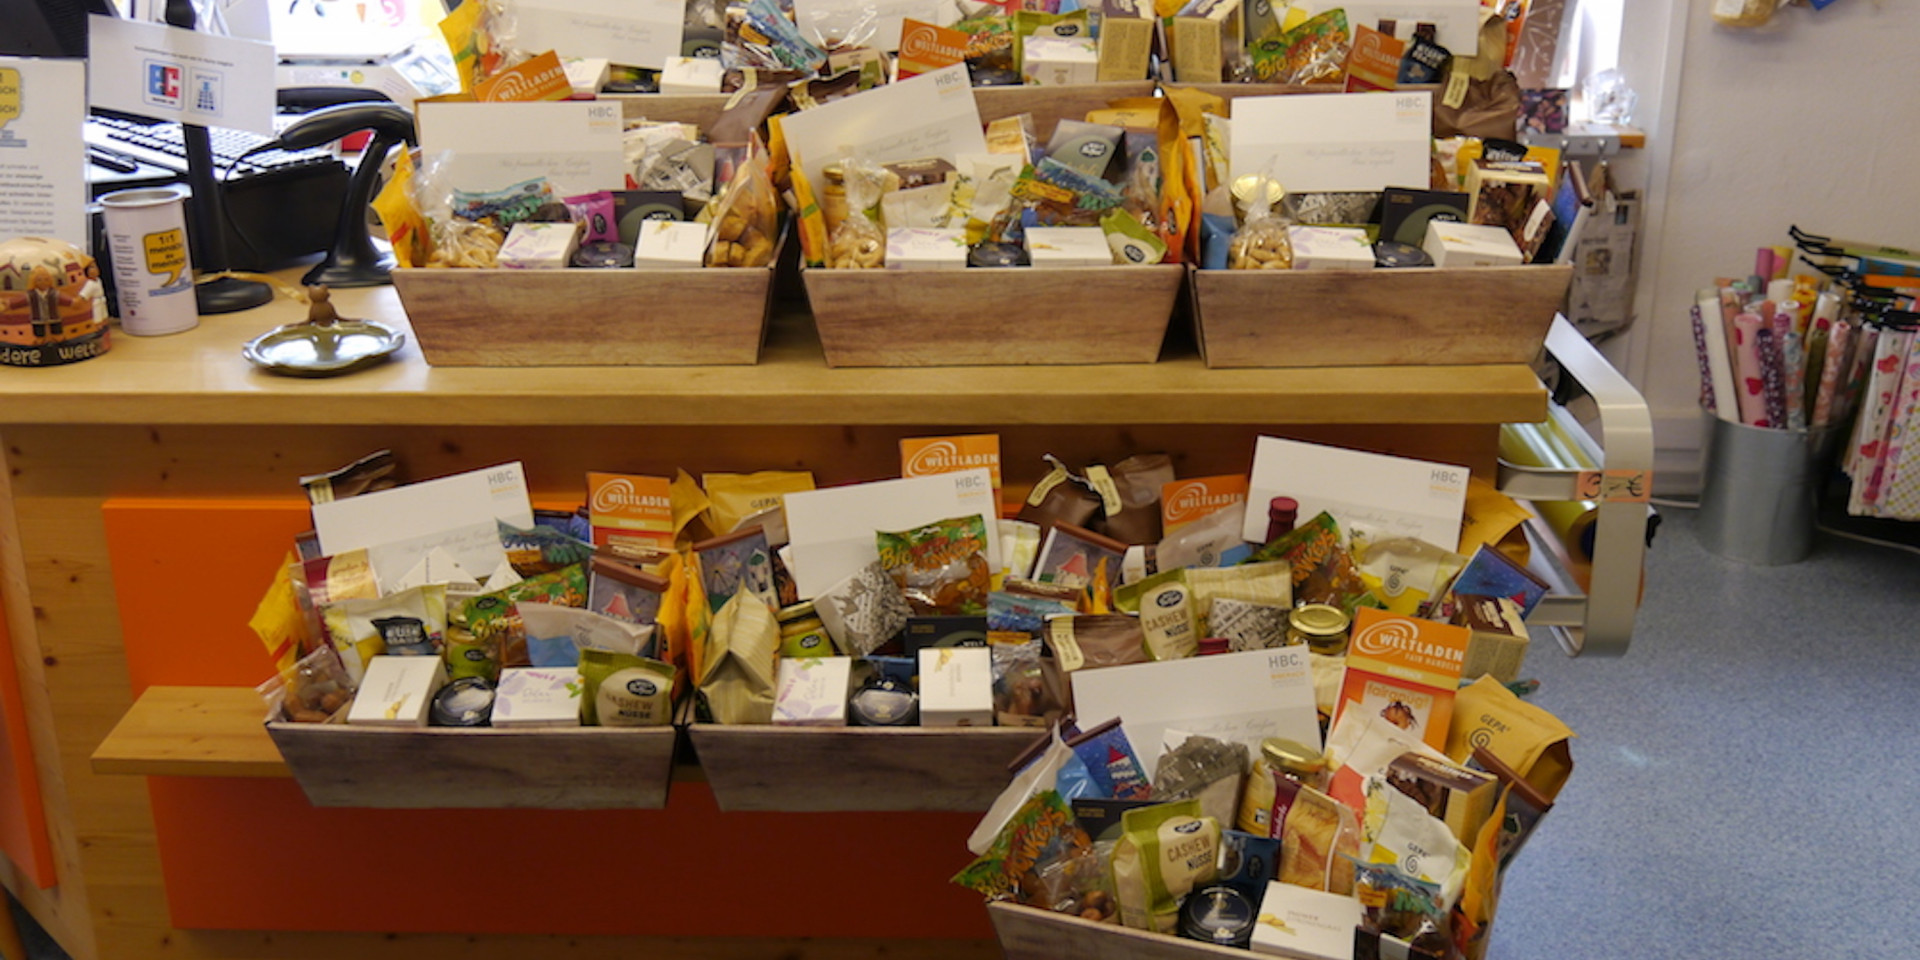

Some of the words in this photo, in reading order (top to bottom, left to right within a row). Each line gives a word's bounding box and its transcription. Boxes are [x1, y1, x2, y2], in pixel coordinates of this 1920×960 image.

[924, 454, 998, 466] WELTLADEN
[1430, 469, 1461, 484] HBC.
[607, 492, 670, 508] WELTLADEN
[1378, 632, 1464, 662] WELTLADEN
[1268, 654, 1304, 669] HBC.
[1167, 835, 1212, 862] CASHEW
